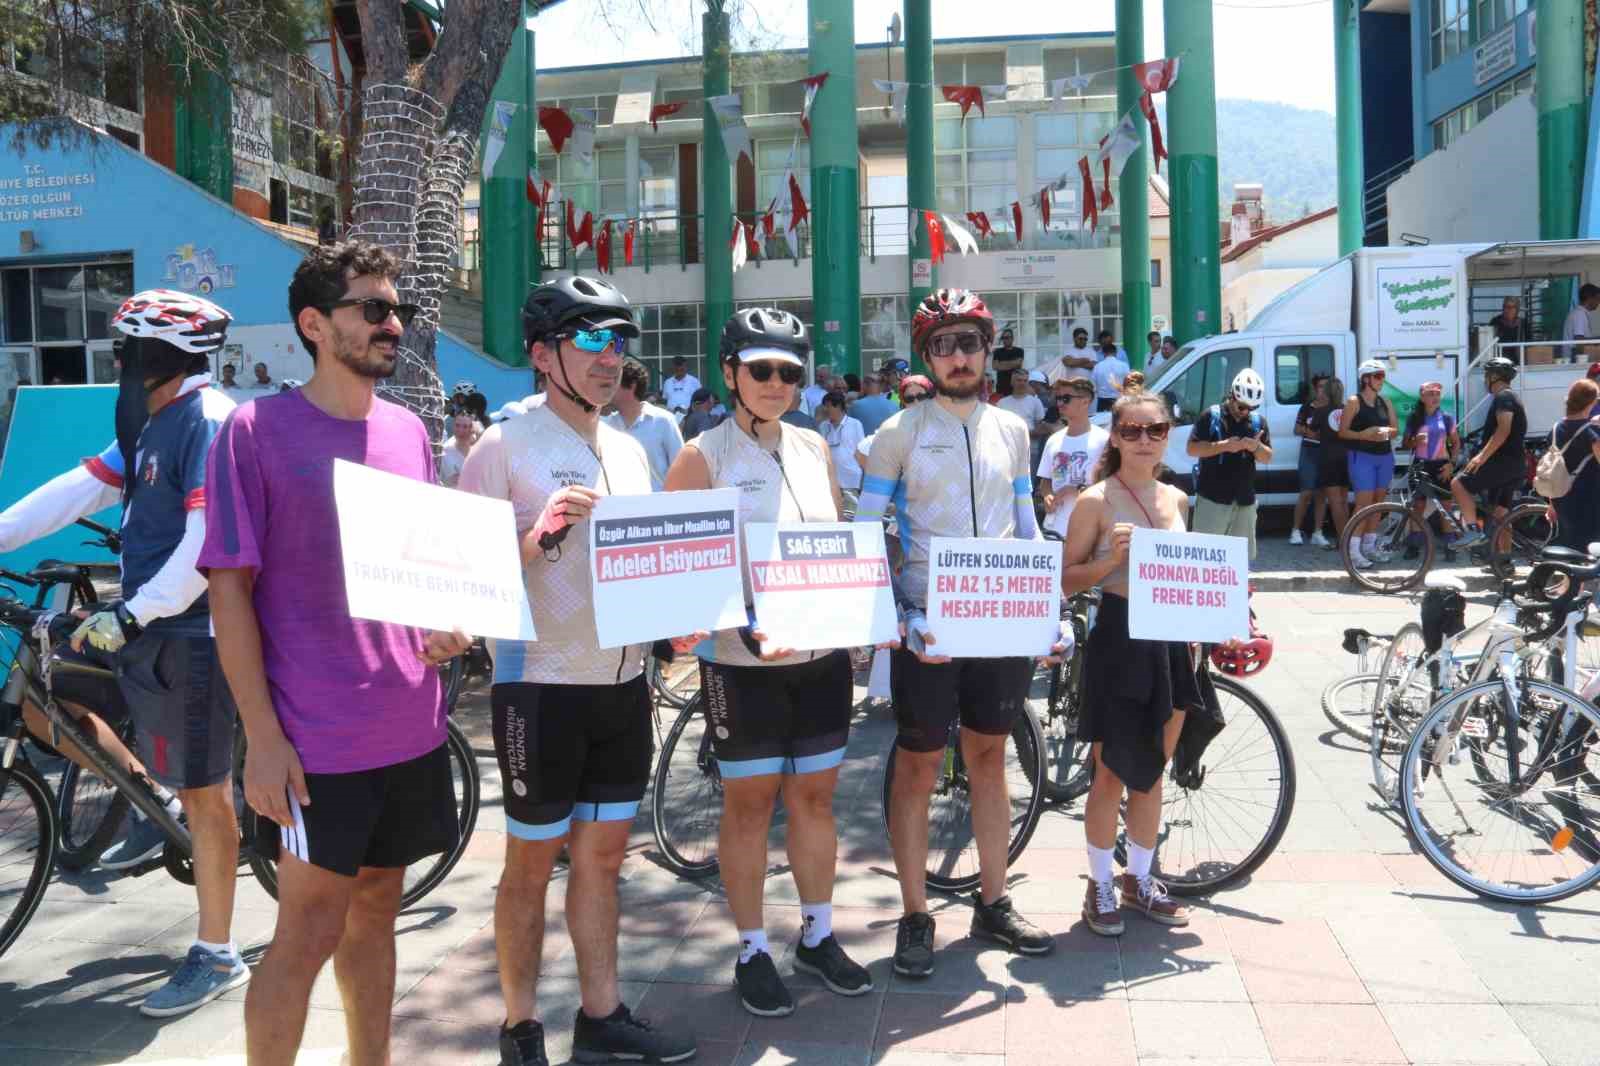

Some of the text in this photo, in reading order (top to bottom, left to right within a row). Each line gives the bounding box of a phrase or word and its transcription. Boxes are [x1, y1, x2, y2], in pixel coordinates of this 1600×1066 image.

[599, 526, 626, 542] Özgür
[653, 526, 663, 537] ve
[786, 535, 848, 557] SAĞ ŞERİT
[1155, 543, 1227, 564] YOLU PAYLAŞ!
[601, 543, 732, 579] Adelet İstiyoruz!
[937, 549, 1056, 573] LÜTFEN SOLDAN GEÇ,
[753, 562, 886, 586] YASAL HAKKIMIZ!
[936, 575, 1053, 596] EN AZ 1,5 METRE
[1138, 562, 1239, 586] KORNAYA DEĞİL
[941, 600, 1049, 618] MESAFE BIRAK!
[1152, 587, 1226, 608] FRENE BAS!
[714, 674, 729, 719] SPONTAN
[515, 717, 527, 771] SPONTAN
